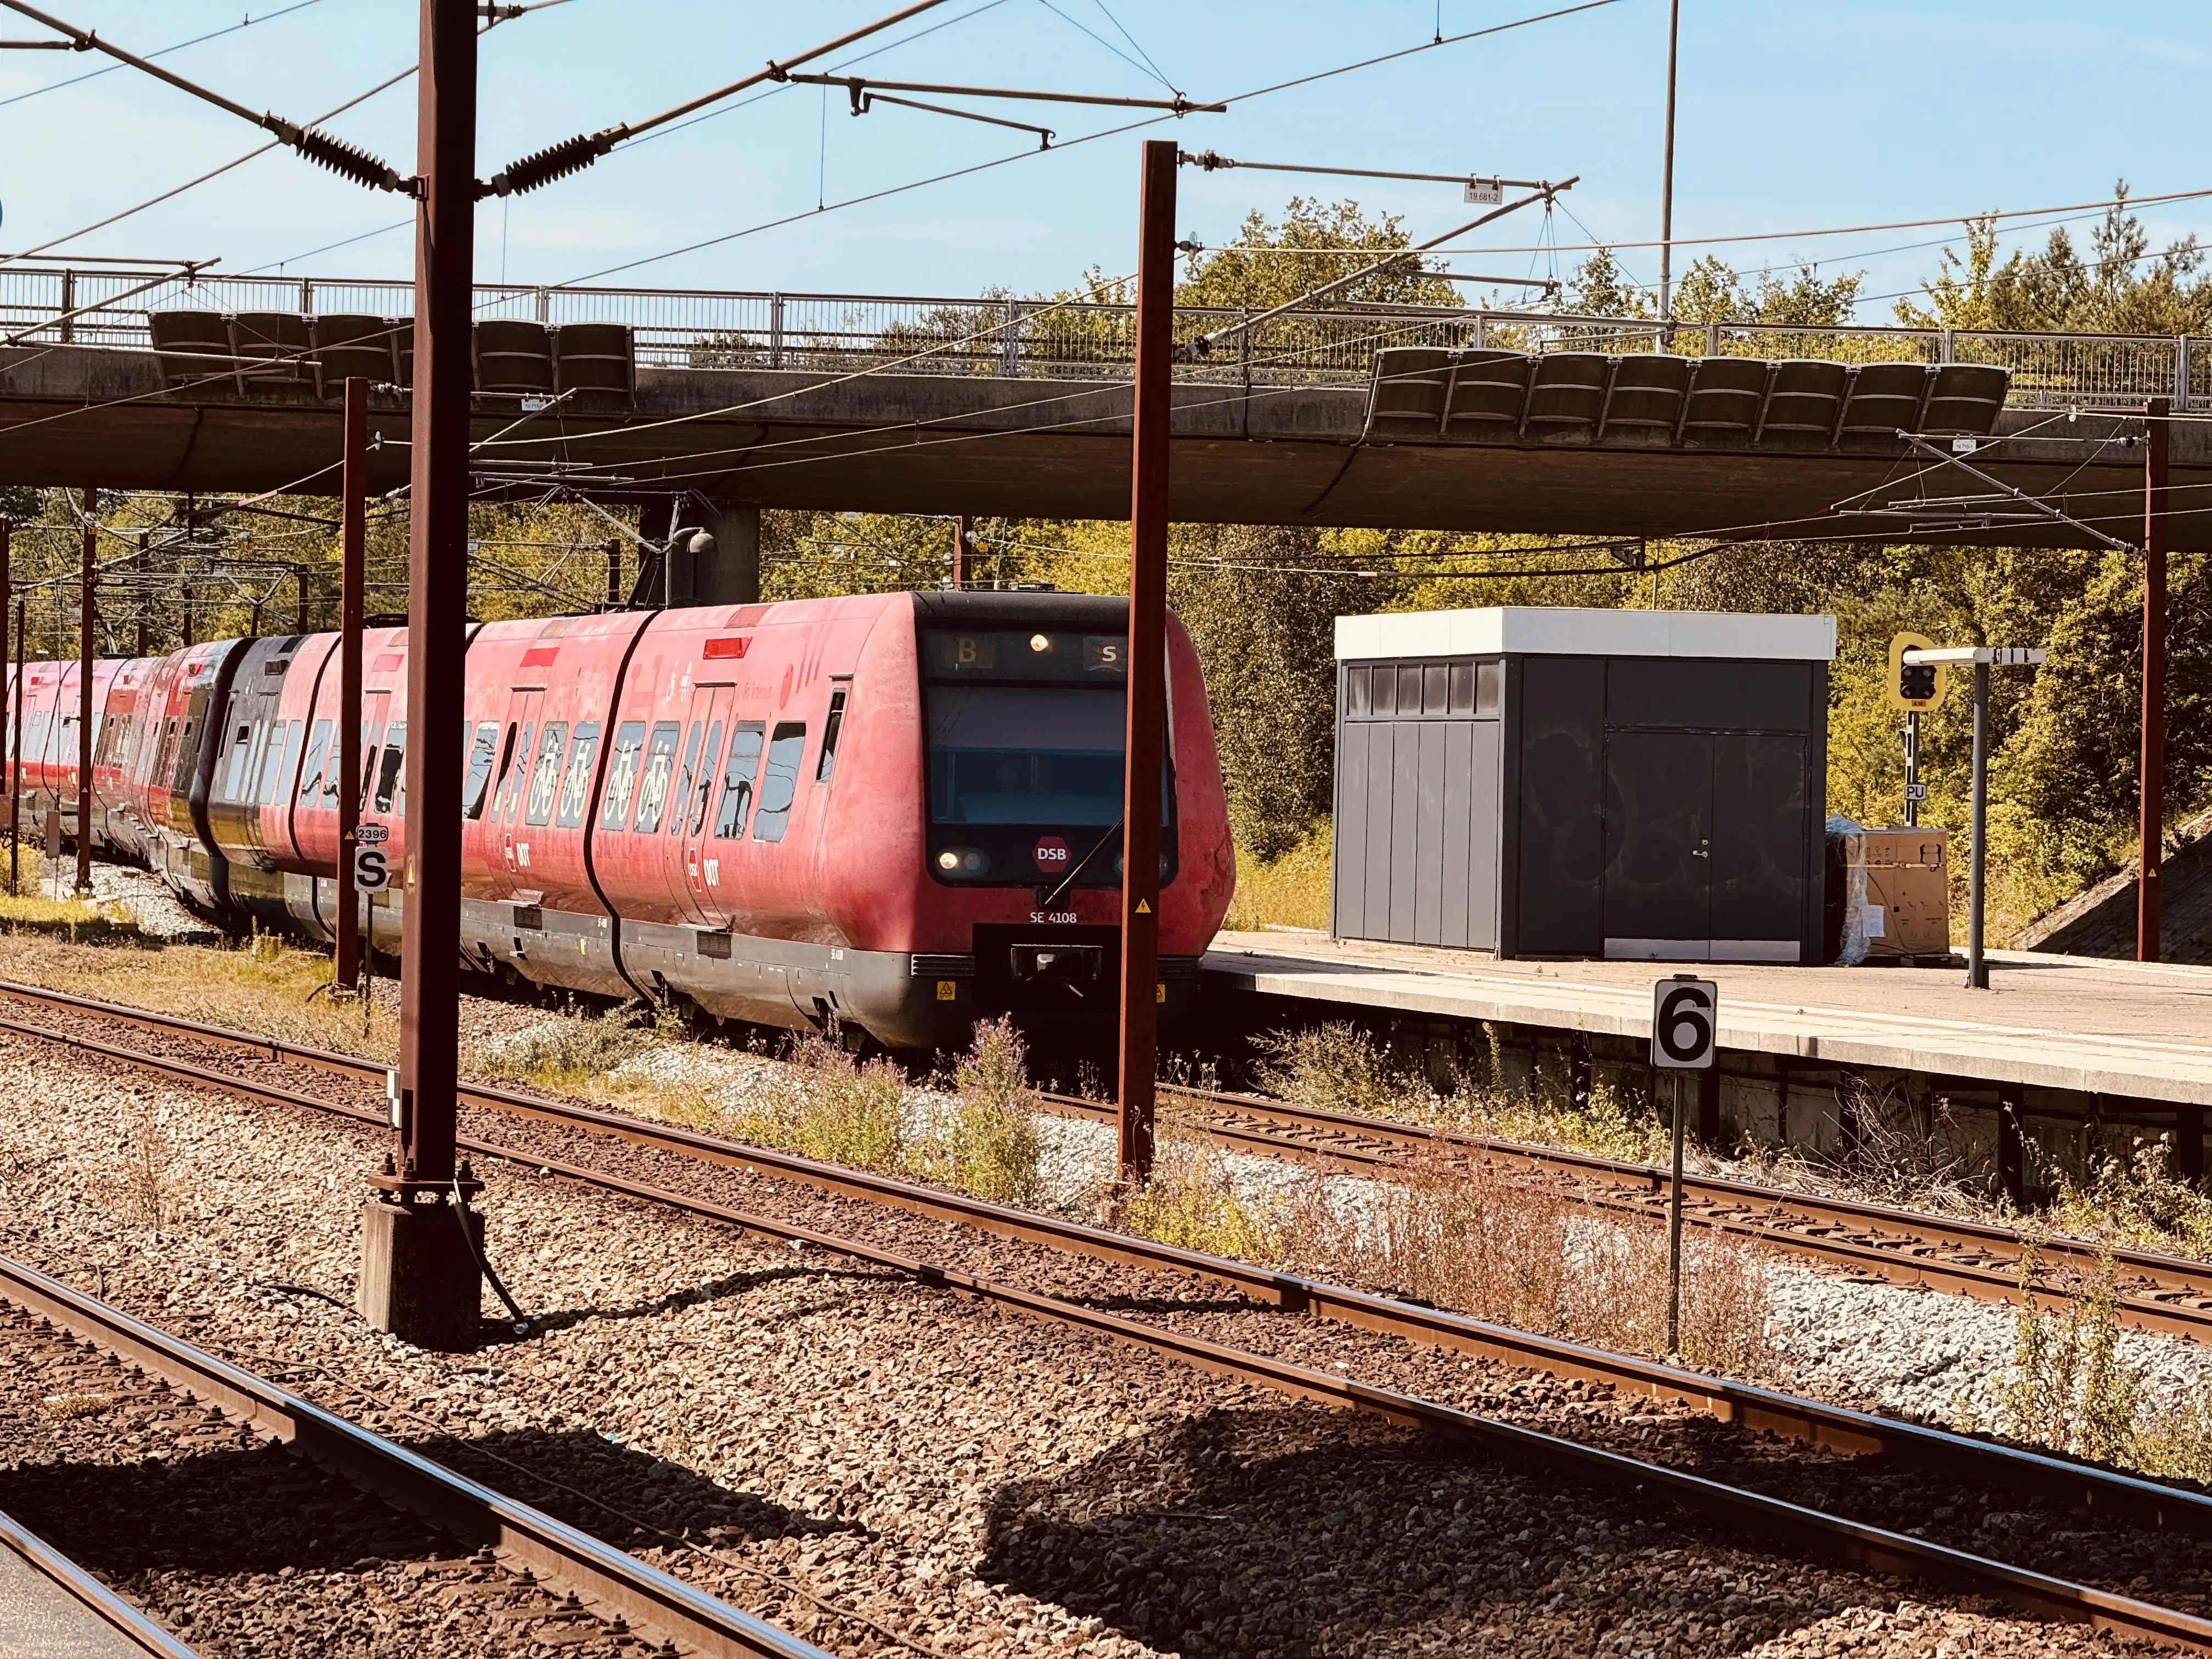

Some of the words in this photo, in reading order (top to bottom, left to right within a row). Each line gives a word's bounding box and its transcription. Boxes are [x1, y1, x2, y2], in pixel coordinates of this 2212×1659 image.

[958, 637, 976, 663] B
[1907, 786, 1924, 798] PU
[358, 830, 387, 839] 2396
[1037, 848, 1066, 860] DSB
[357, 851, 386, 887] S
[703, 859, 720, 887] DOT
[1030, 912, 1045, 923] SE
[1048, 912, 1077, 923] 4108
[1658, 987, 1711, 1062] 6
